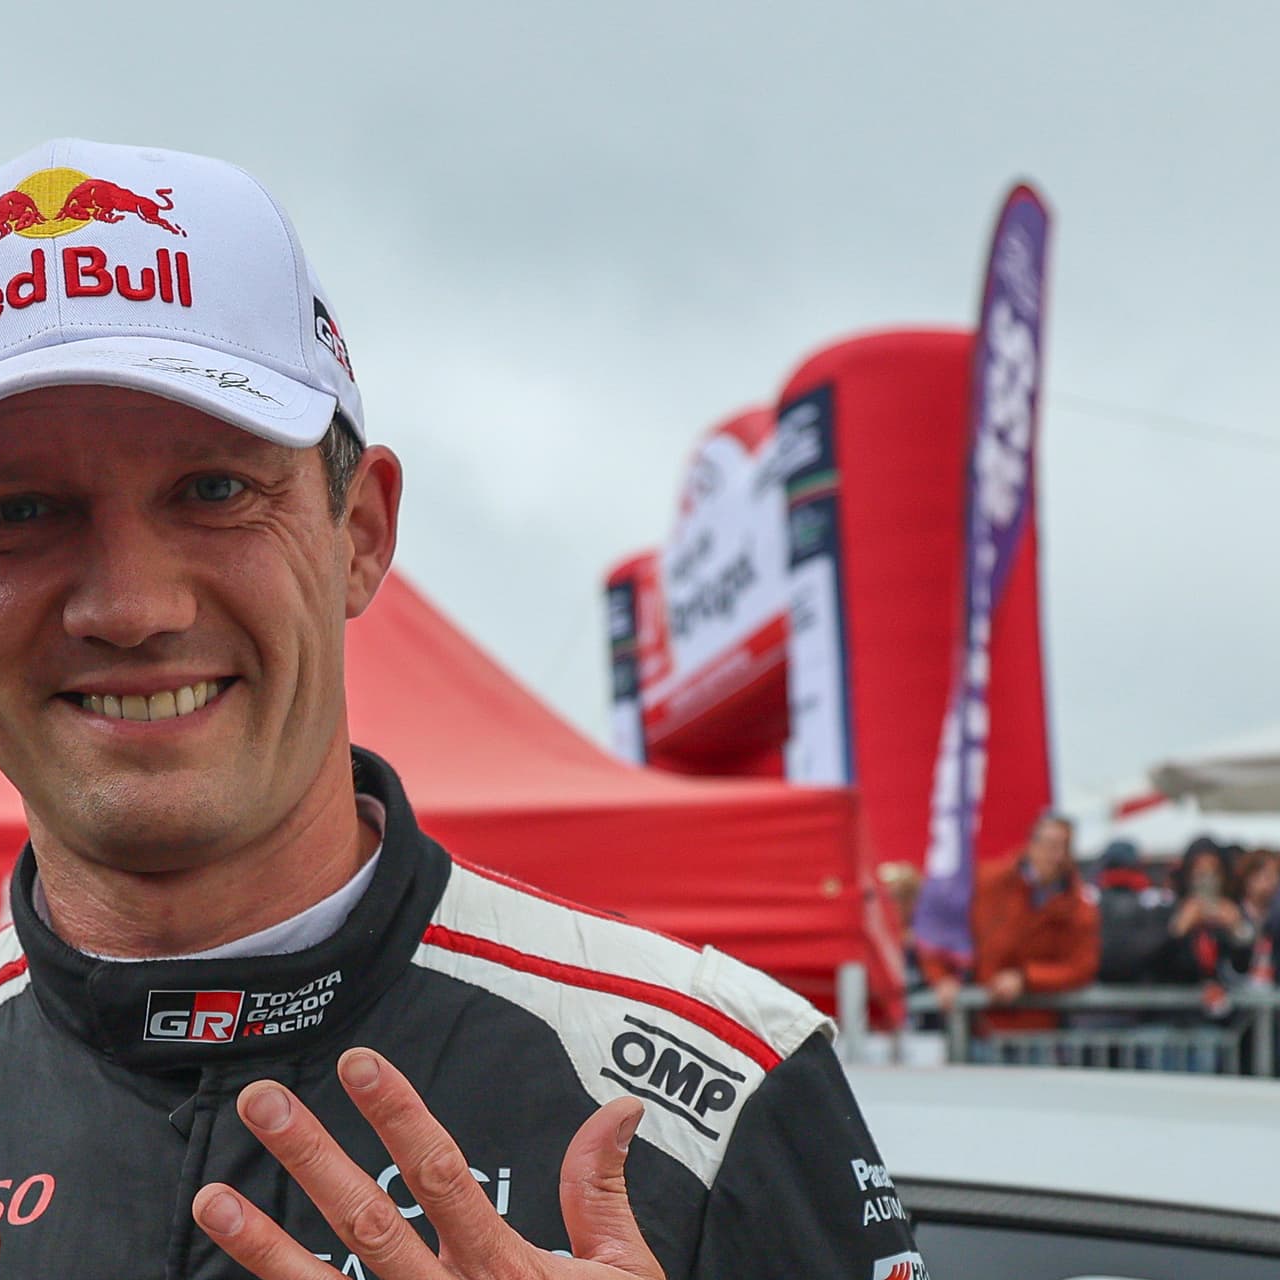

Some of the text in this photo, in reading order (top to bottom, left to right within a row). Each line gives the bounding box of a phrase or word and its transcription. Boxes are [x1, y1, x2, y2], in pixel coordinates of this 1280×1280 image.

[62, 245, 193, 308] Bull
[246, 990, 335, 1022] GAZOO
[251, 970, 343, 1008] TOYOTA
[149, 1010, 235, 1039] GR
[611, 1031, 737, 1118] OMP
